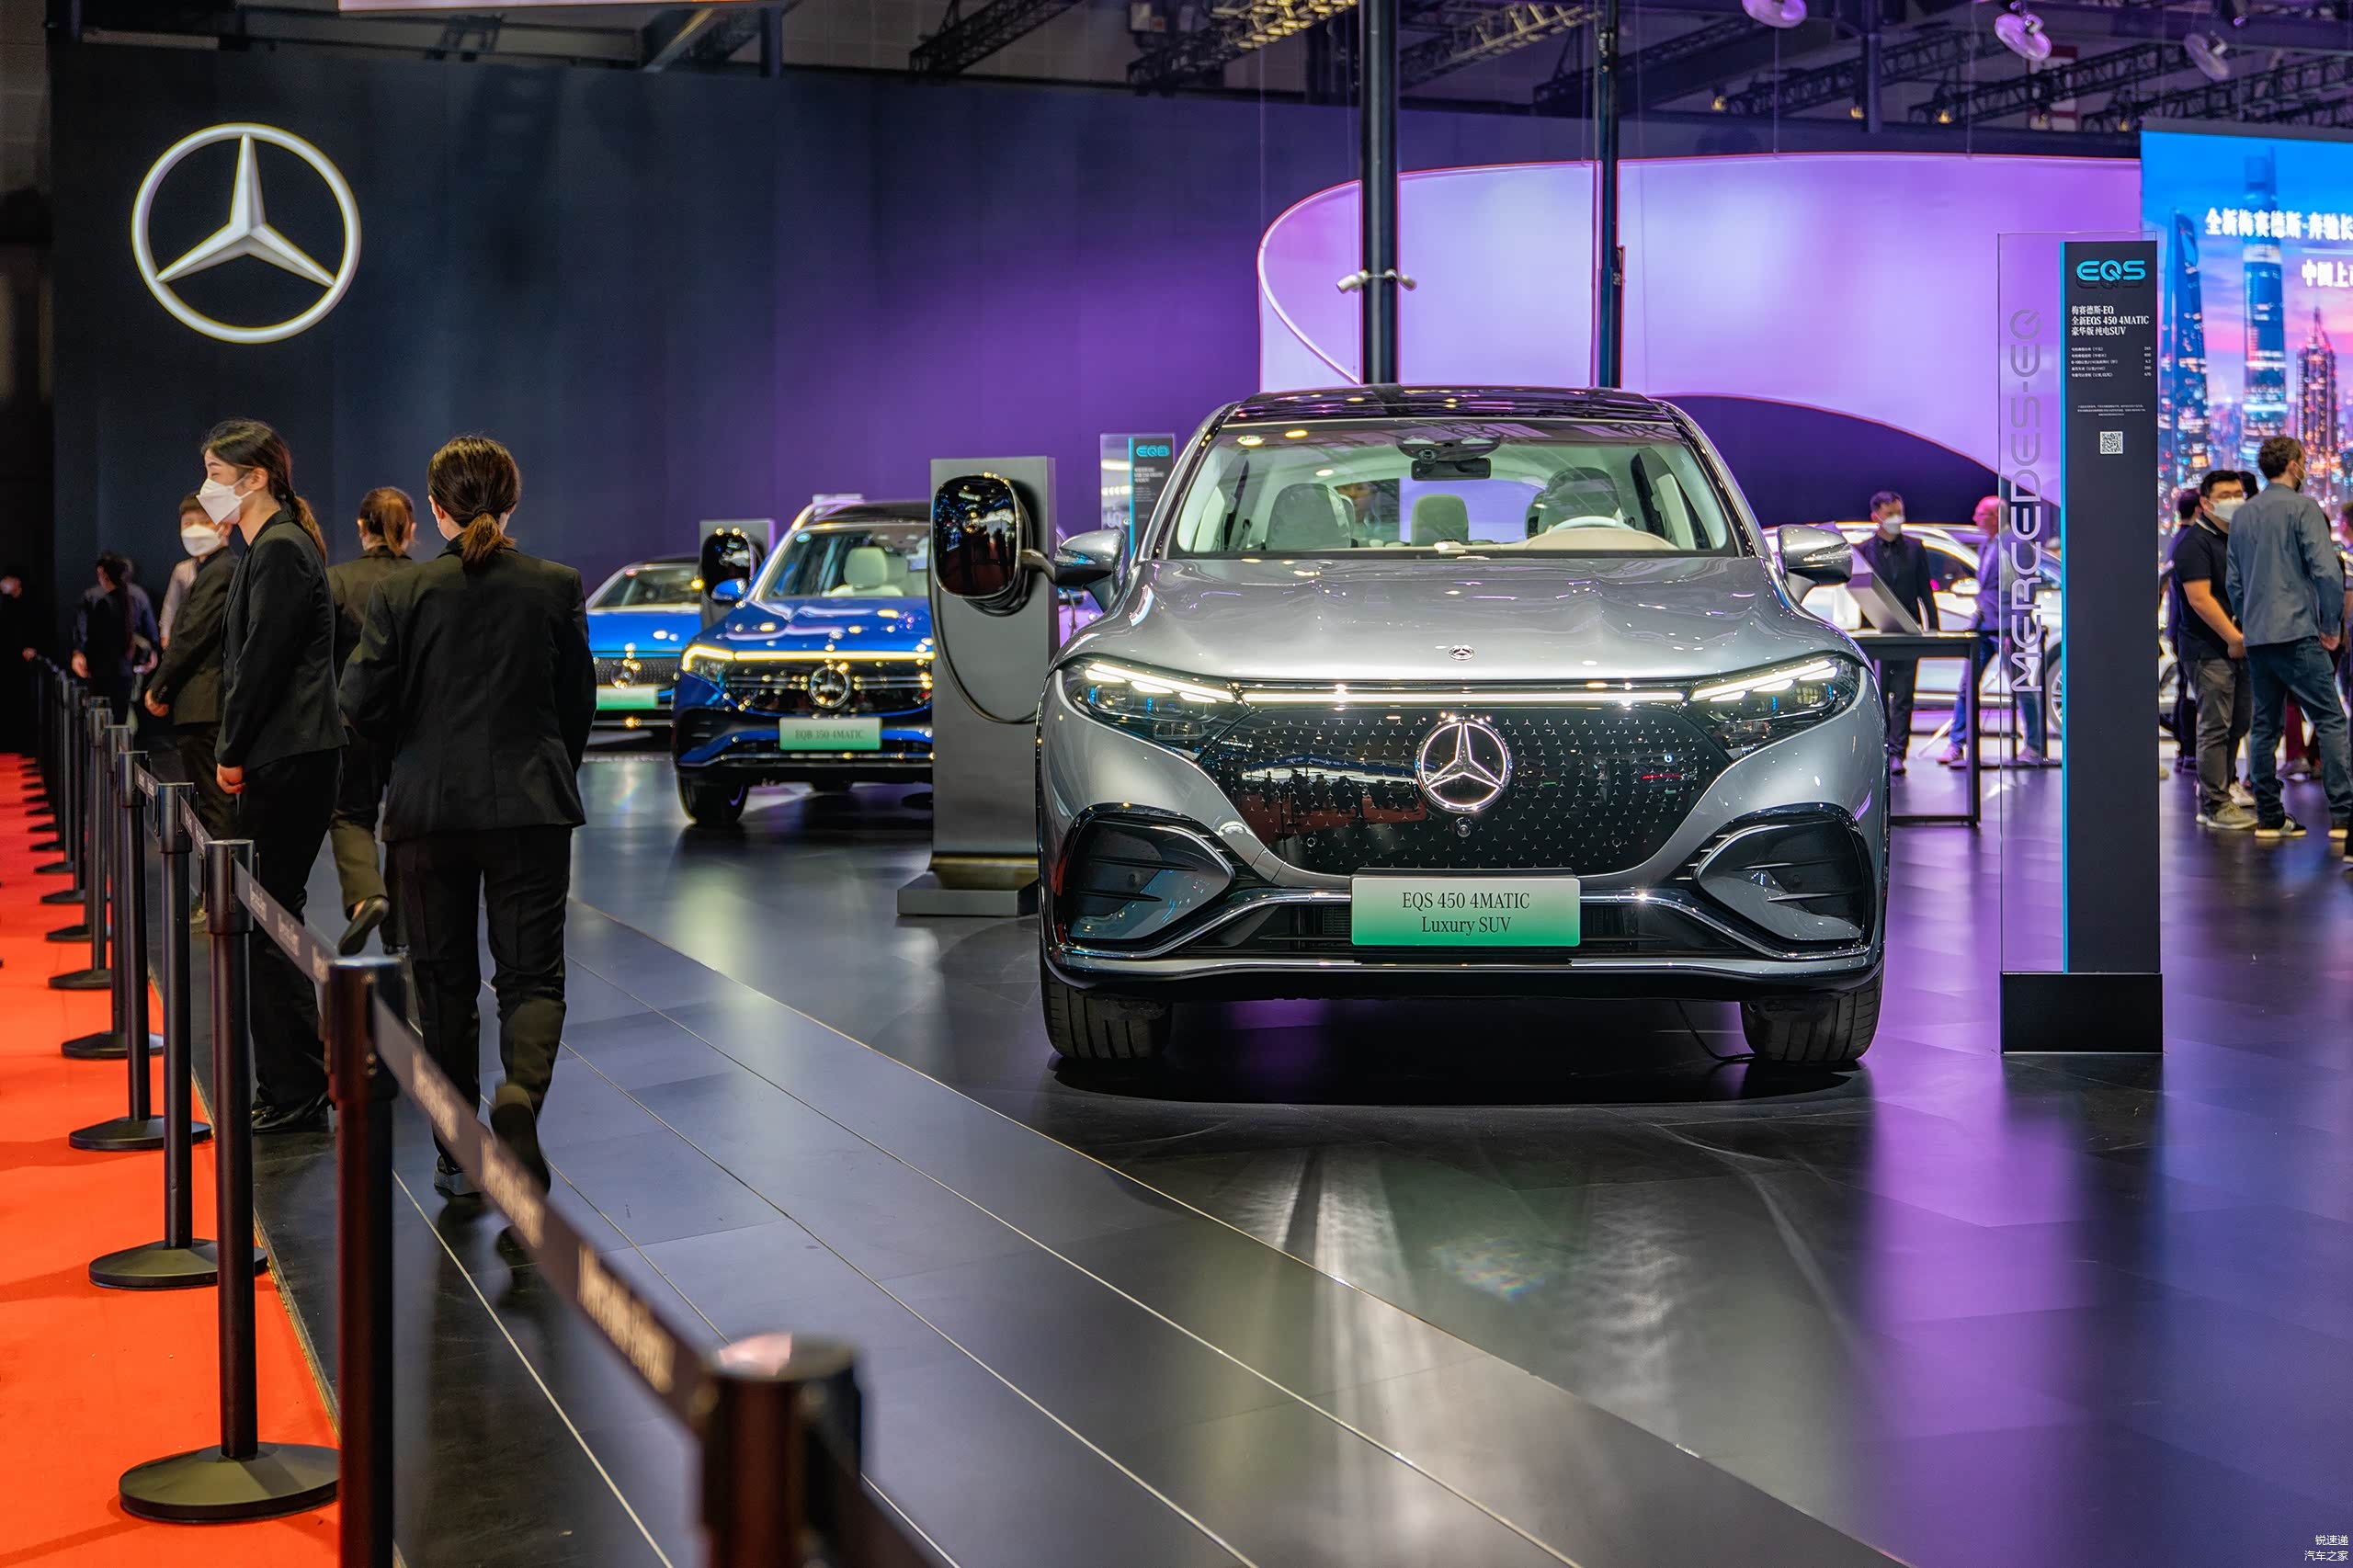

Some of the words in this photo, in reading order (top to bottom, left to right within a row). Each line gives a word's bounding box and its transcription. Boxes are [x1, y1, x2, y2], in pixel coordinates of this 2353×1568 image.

[2077, 260, 2146, 281] EQS
[2103, 316, 2118, 325] 450
[2119, 315, 2150, 325] 4MATIC
[1136, 446, 1169, 457] EQB
[2009, 309, 2042, 693] MERCEDES-EQ
[1402, 892, 1433, 911] EQS
[1437, 892, 1465, 909] 450
[1470, 892, 1530, 909] 4MATIC
[1421, 916, 1475, 937] Luxury
[1478, 916, 1512, 933] SUV
